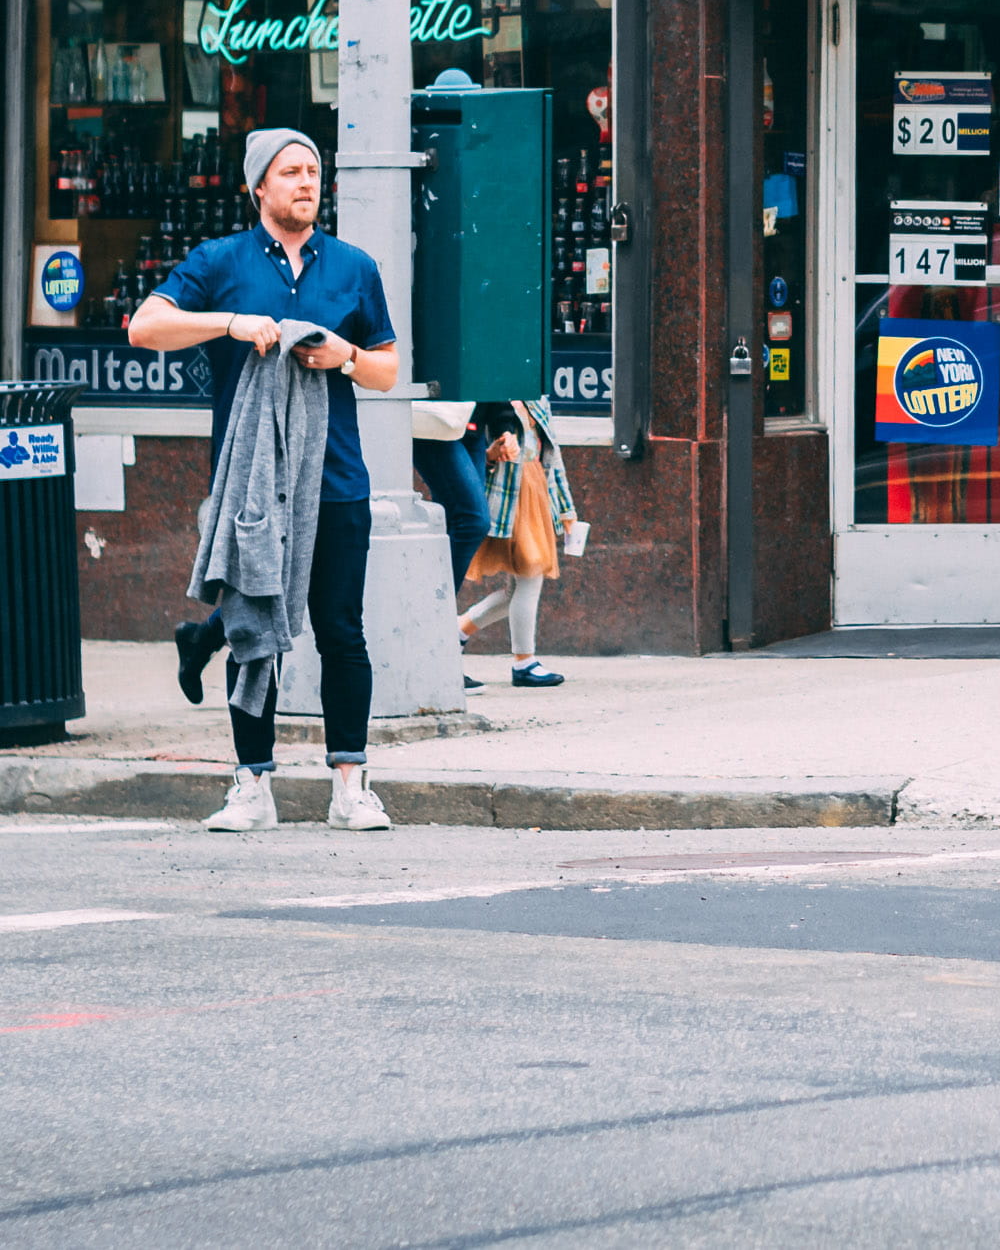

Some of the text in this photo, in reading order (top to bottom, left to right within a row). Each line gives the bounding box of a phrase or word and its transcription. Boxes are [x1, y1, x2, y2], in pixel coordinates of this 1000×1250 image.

[958, 128, 990, 136] MILLION
[954, 257, 986, 267] MILLION
[45, 279, 80, 295] LOTTERY
[936, 347, 966, 363] NEW
[33, 348, 184, 392] Malteds
[938, 363, 975, 384] YORK
[903, 382, 979, 415] LOTTERY
[28, 432, 54, 444] Ready
[32, 443, 59, 454] Willing
[40, 453, 57, 463] Able
